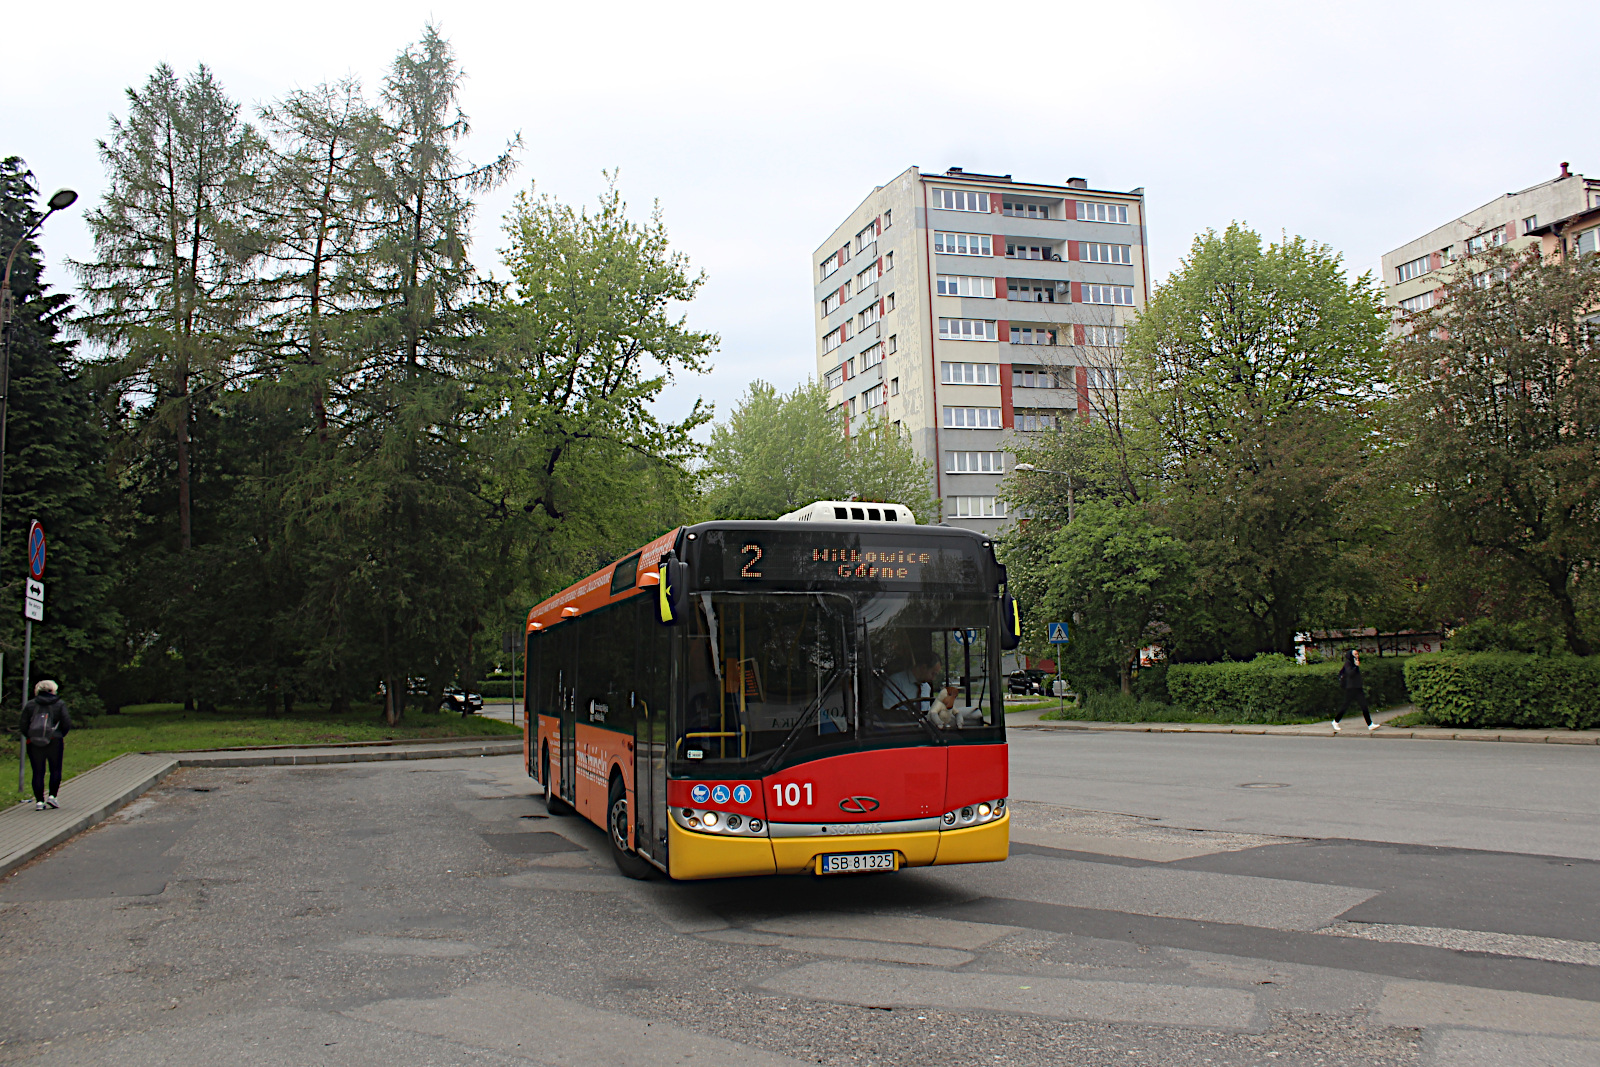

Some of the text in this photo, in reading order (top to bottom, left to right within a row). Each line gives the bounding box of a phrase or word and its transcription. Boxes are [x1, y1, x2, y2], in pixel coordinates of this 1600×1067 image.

[740, 544, 930, 577] 2 Wilkowice
[838, 563, 908, 578] Górne
[773, 783, 813, 806] 101
[830, 823, 883, 836] SOLARIS
[831, 854, 893, 870] SB 81325
